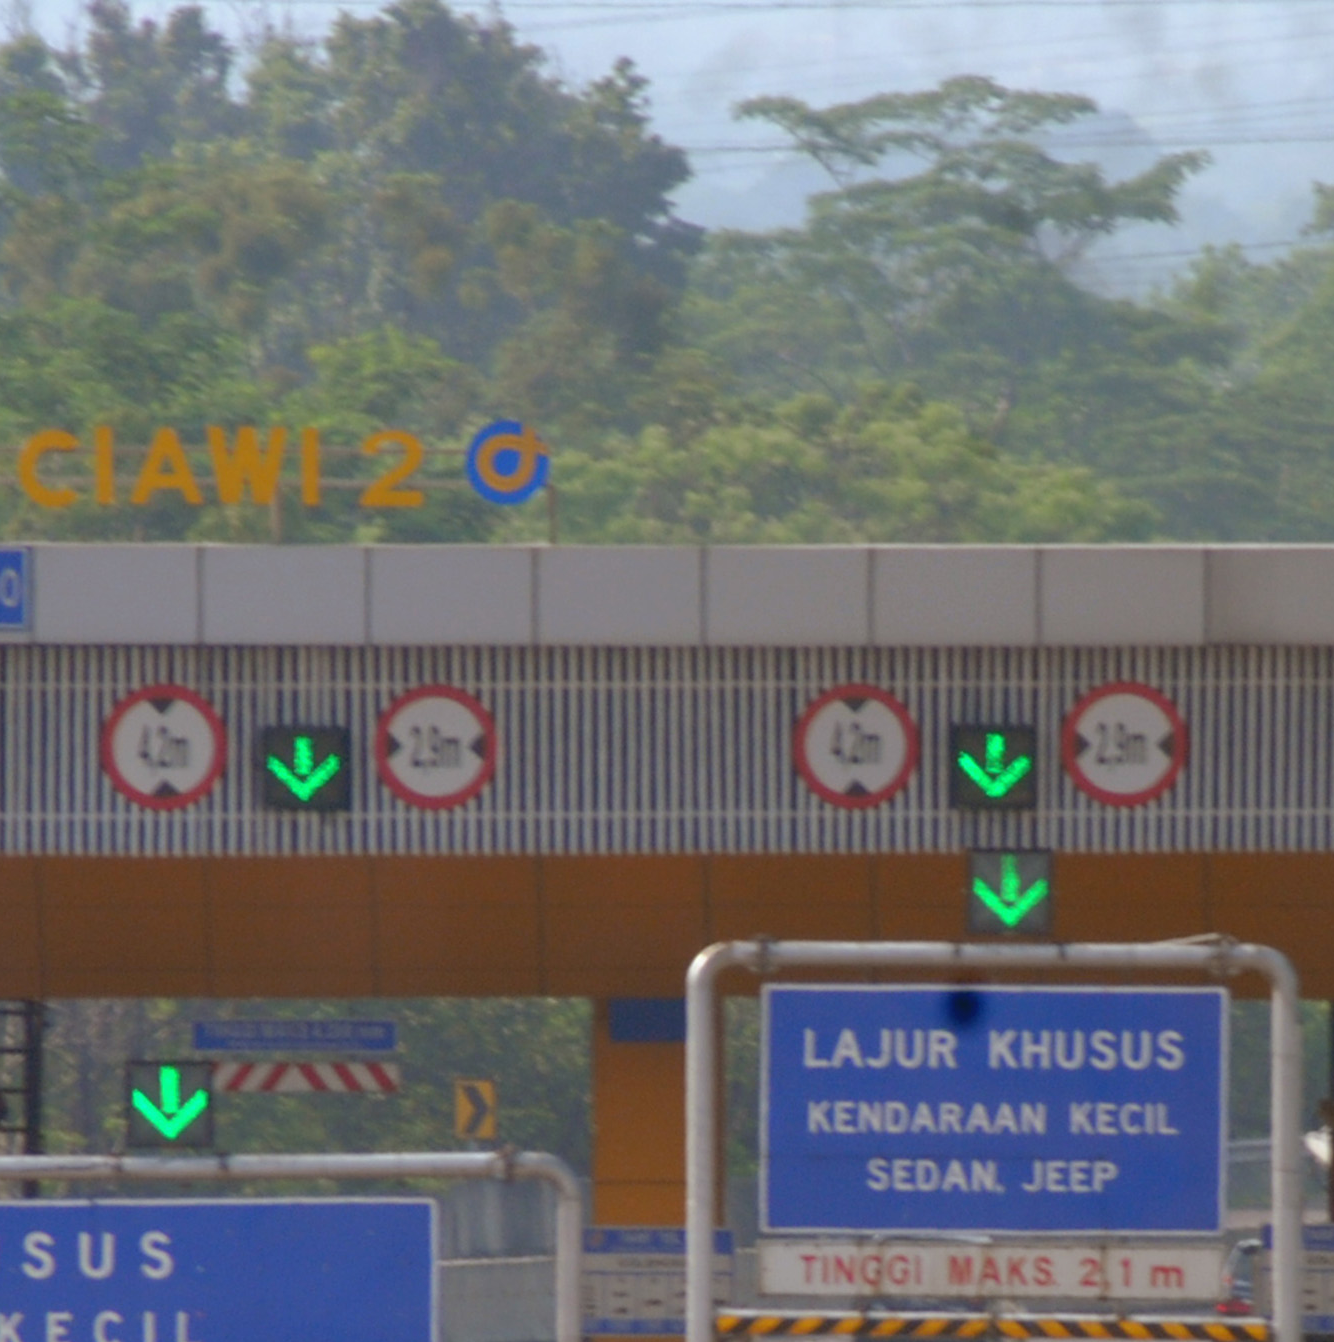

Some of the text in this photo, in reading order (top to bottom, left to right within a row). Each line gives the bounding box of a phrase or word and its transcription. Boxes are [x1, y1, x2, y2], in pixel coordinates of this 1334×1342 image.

[16, 425, 321, 506] CIAWI
[358, 430, 425, 507] 2
[803, 1028, 1186, 1071] LAJUR KHUSUS
[807, 1101, 1180, 1136] KENDARAAN KECIL
[1021, 1160, 1119, 1193] JEEP
[800, 1254, 923, 1286] TINGGI
[1150, 1264, 1186, 1289] m
